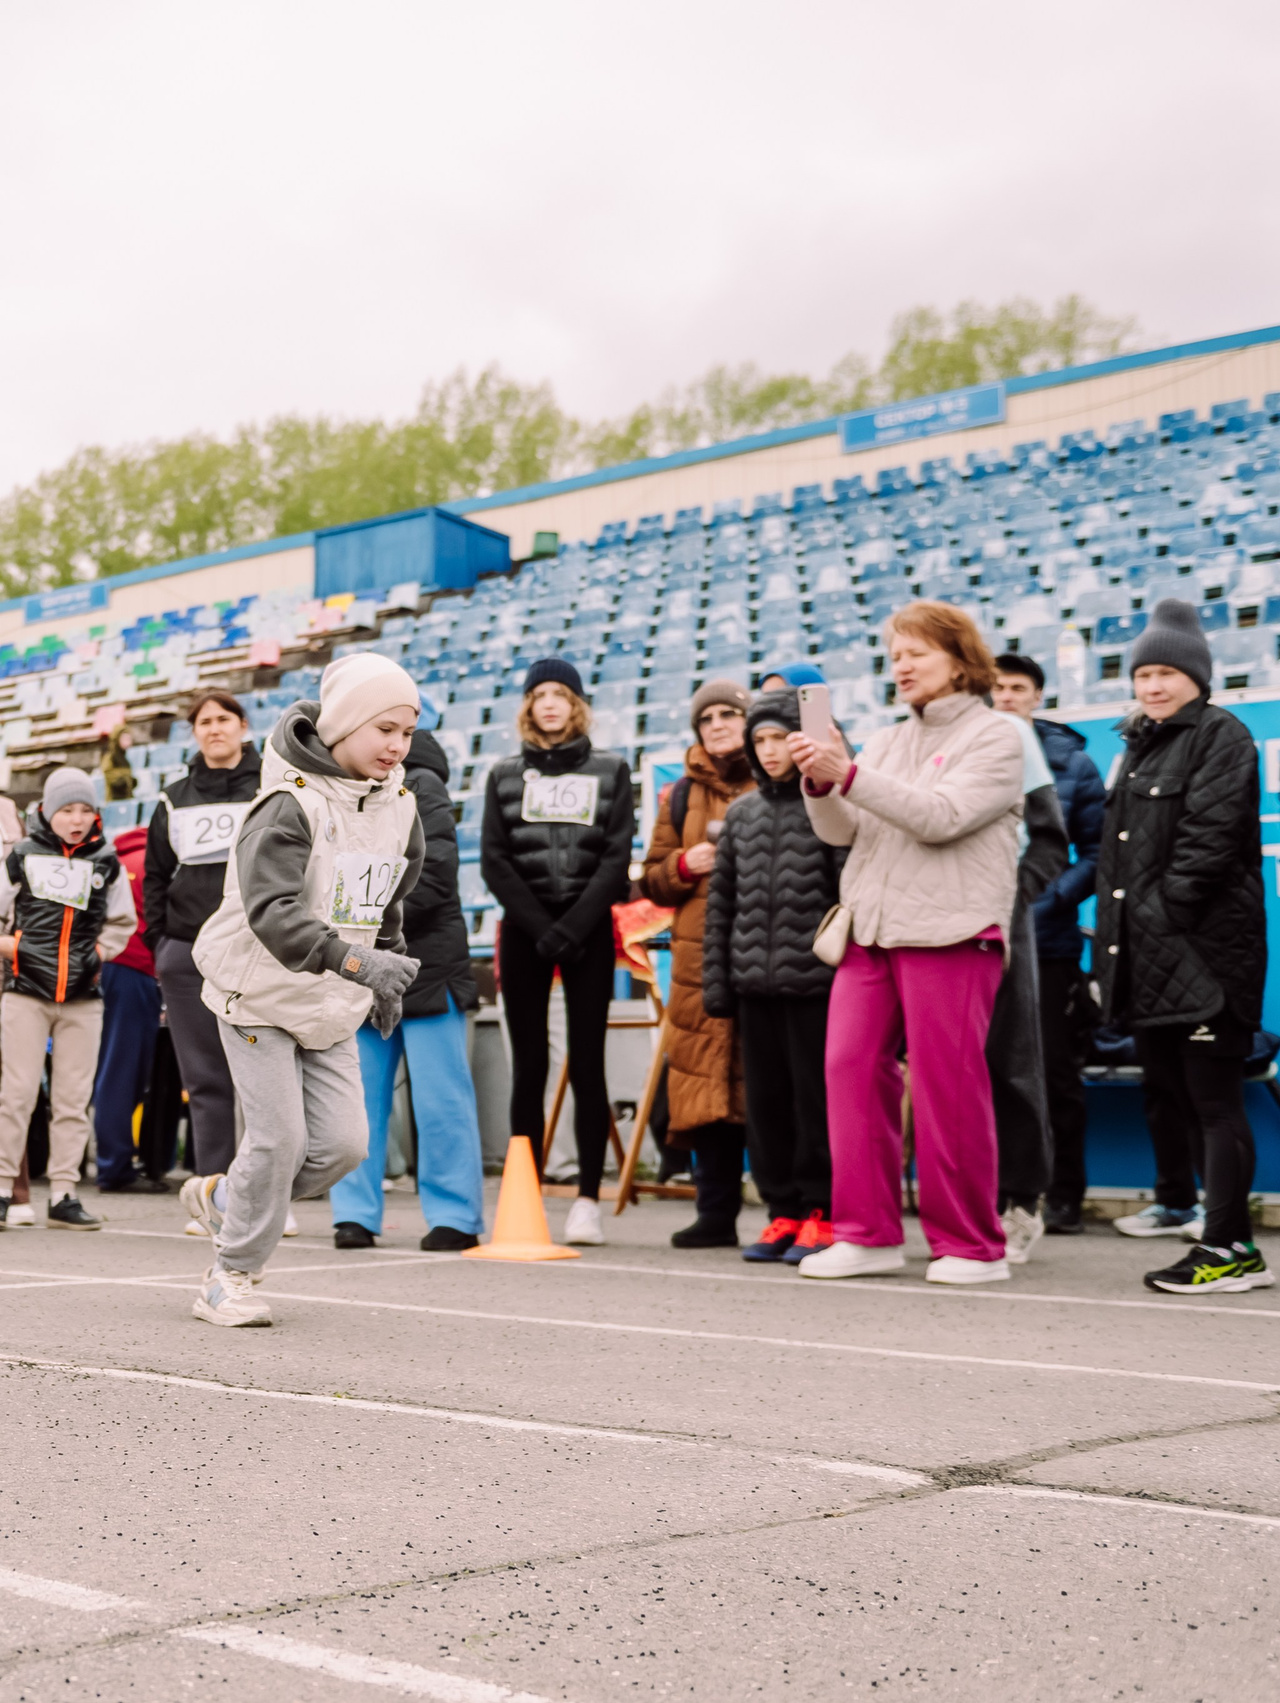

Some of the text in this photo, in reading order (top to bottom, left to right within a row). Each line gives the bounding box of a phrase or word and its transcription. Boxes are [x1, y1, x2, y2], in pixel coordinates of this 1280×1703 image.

[547, 781, 578, 808] 16
[194, 813, 235, 845] 29
[48, 863, 68, 889] 3
[359, 862, 391, 907] 12
